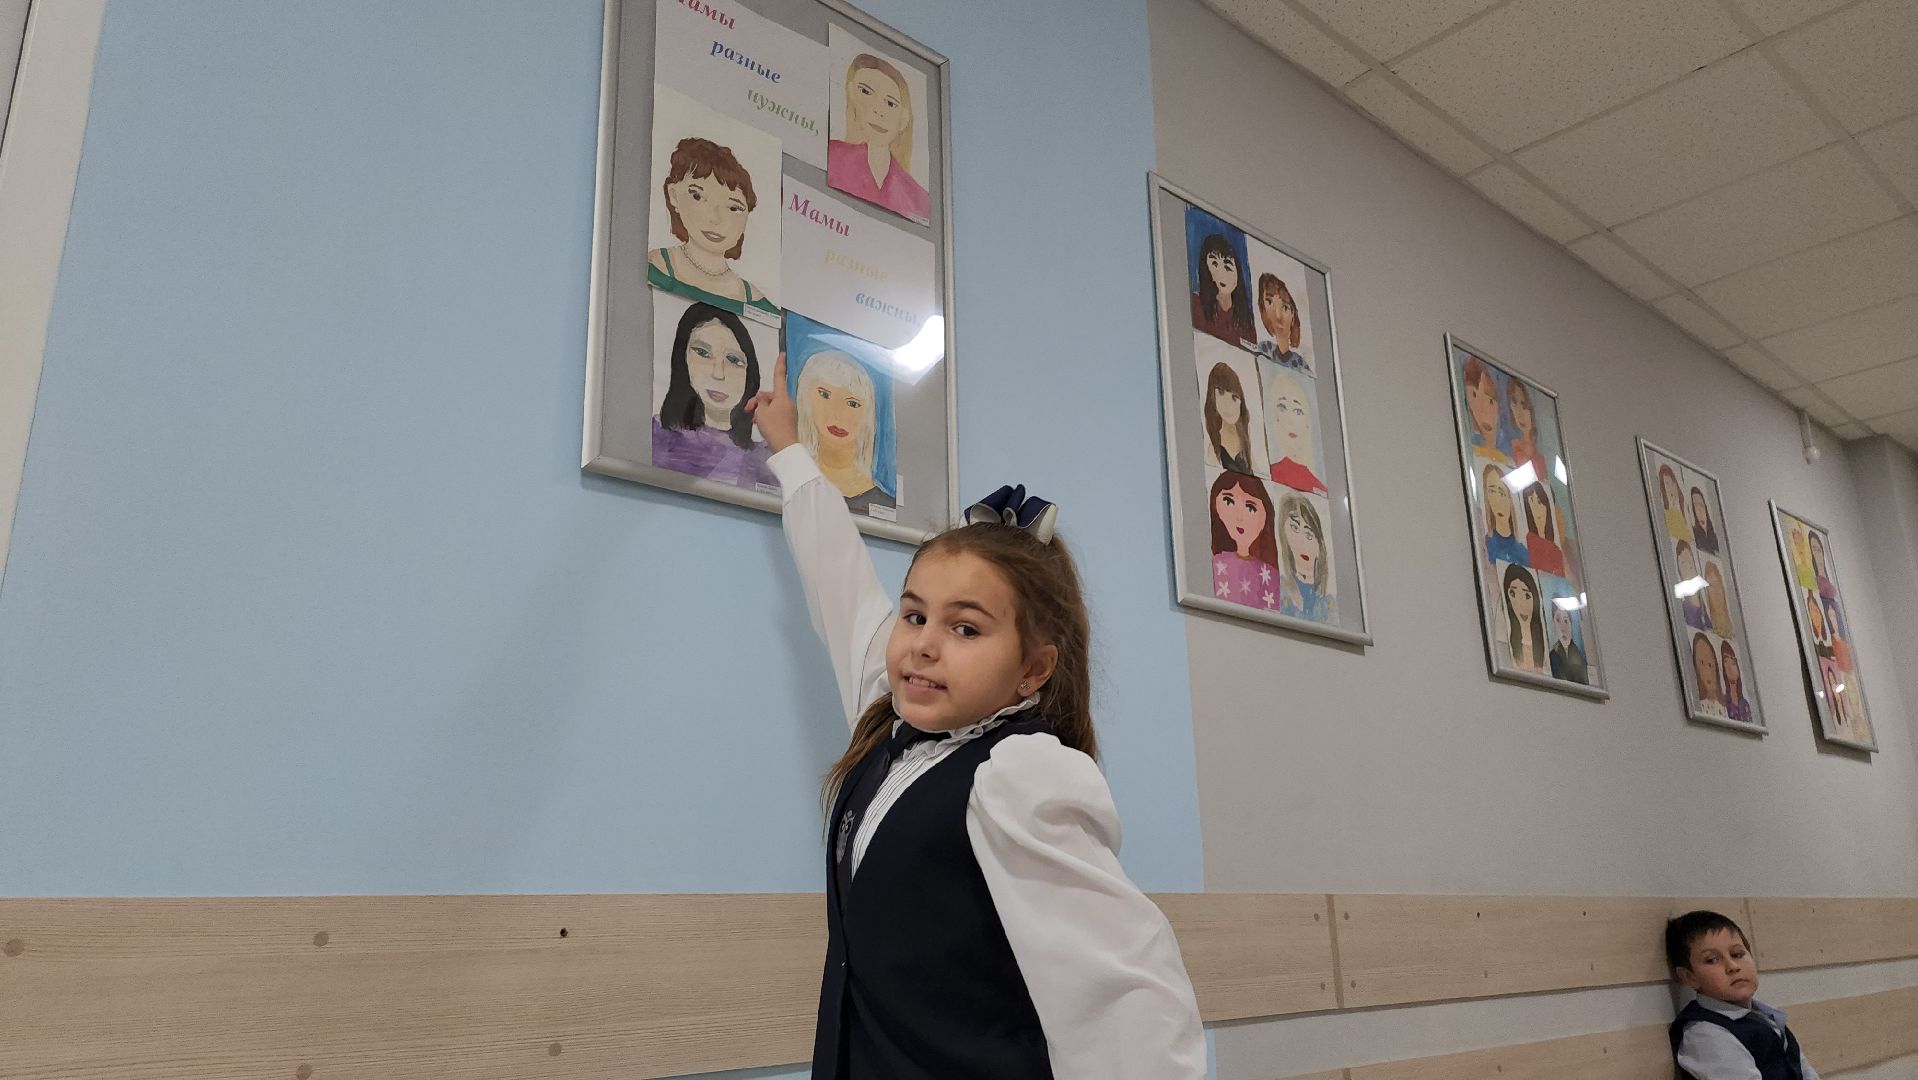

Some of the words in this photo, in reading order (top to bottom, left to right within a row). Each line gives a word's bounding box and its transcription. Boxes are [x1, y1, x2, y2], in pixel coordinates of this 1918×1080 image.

[676, 0, 735, 29] амы
[710, 41, 781, 83] разные
[747, 90, 819, 136] нужны,
[788, 193, 850, 237] Мамы
